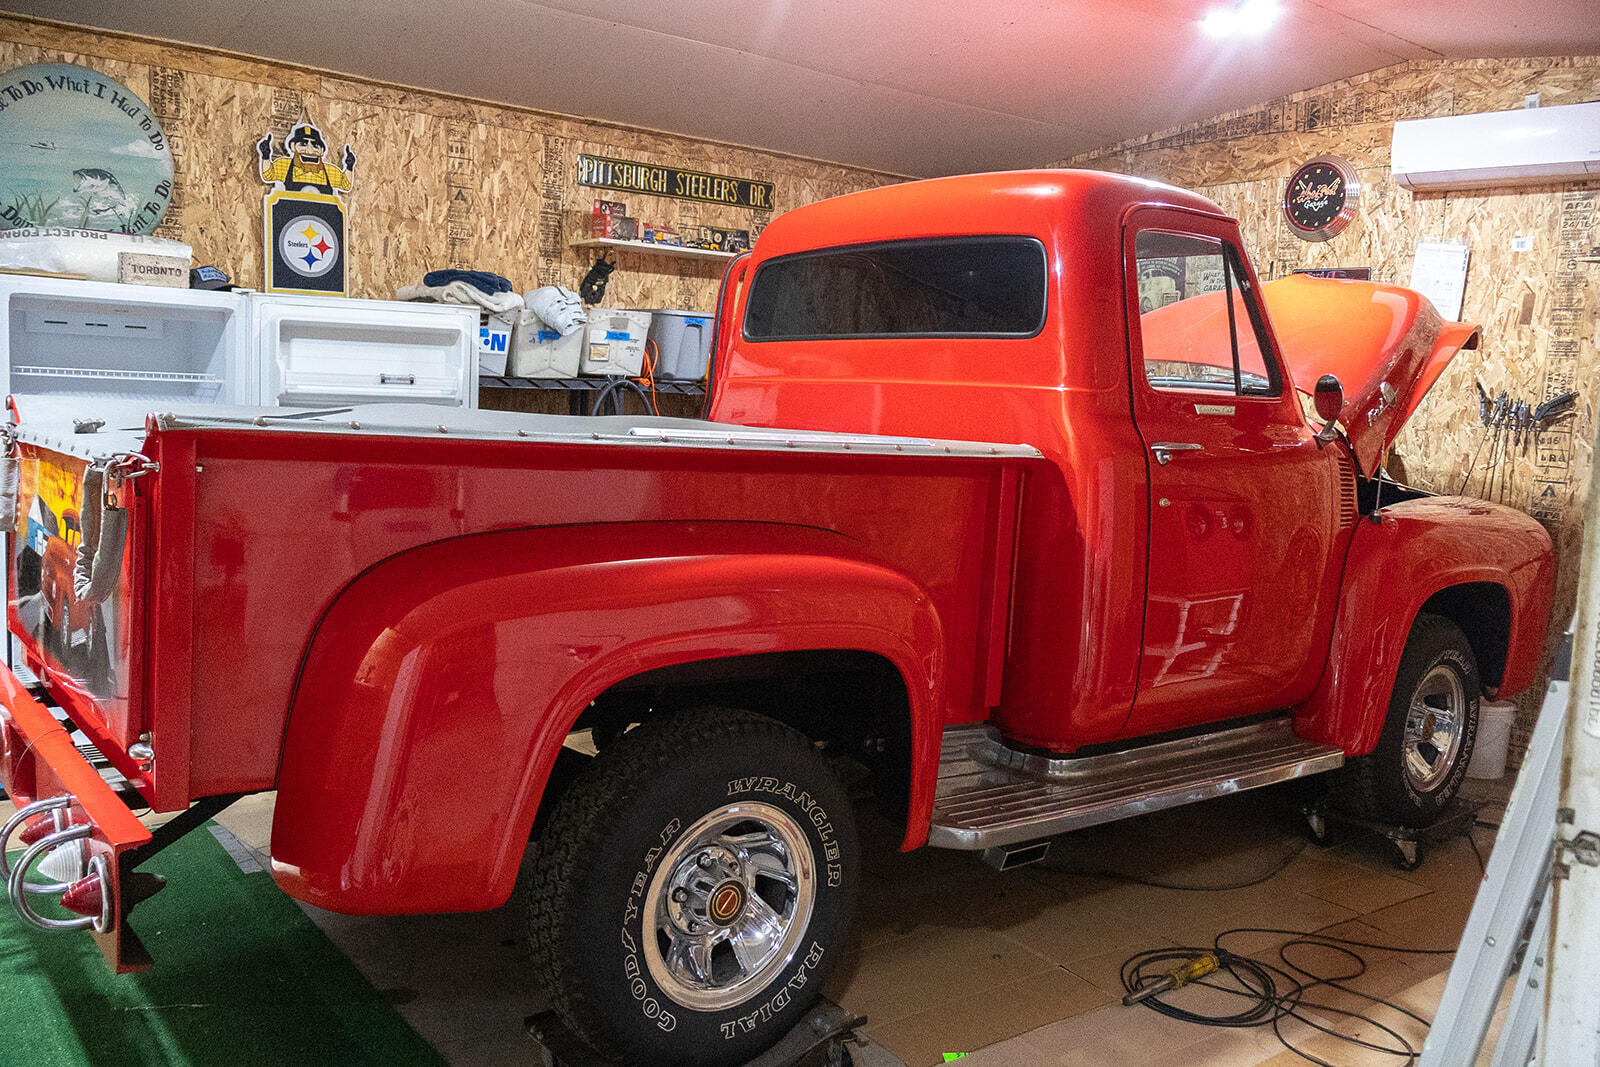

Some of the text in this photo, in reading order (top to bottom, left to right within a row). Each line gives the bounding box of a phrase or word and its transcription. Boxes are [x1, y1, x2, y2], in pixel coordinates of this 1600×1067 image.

[1, 75, 165, 151] To Do What I Had To Do
[143, 201, 161, 216] To
[155, 179, 172, 200] Do
[584, 157, 668, 193] PITTSBURGH
[675, 172, 739, 203] STEELERS
[750, 184, 770, 207] DR.
[1565, 201, 1592, 210] APA
[43, 227, 108, 240] PROJECT
[287, 240, 309, 249] Steelers
[131, 264, 182, 277] TORONTO
[727, 777, 842, 887] WRANGLER
[621, 817, 682, 1032] GOODYEAR
[720, 941, 825, 1040] RADIAL
